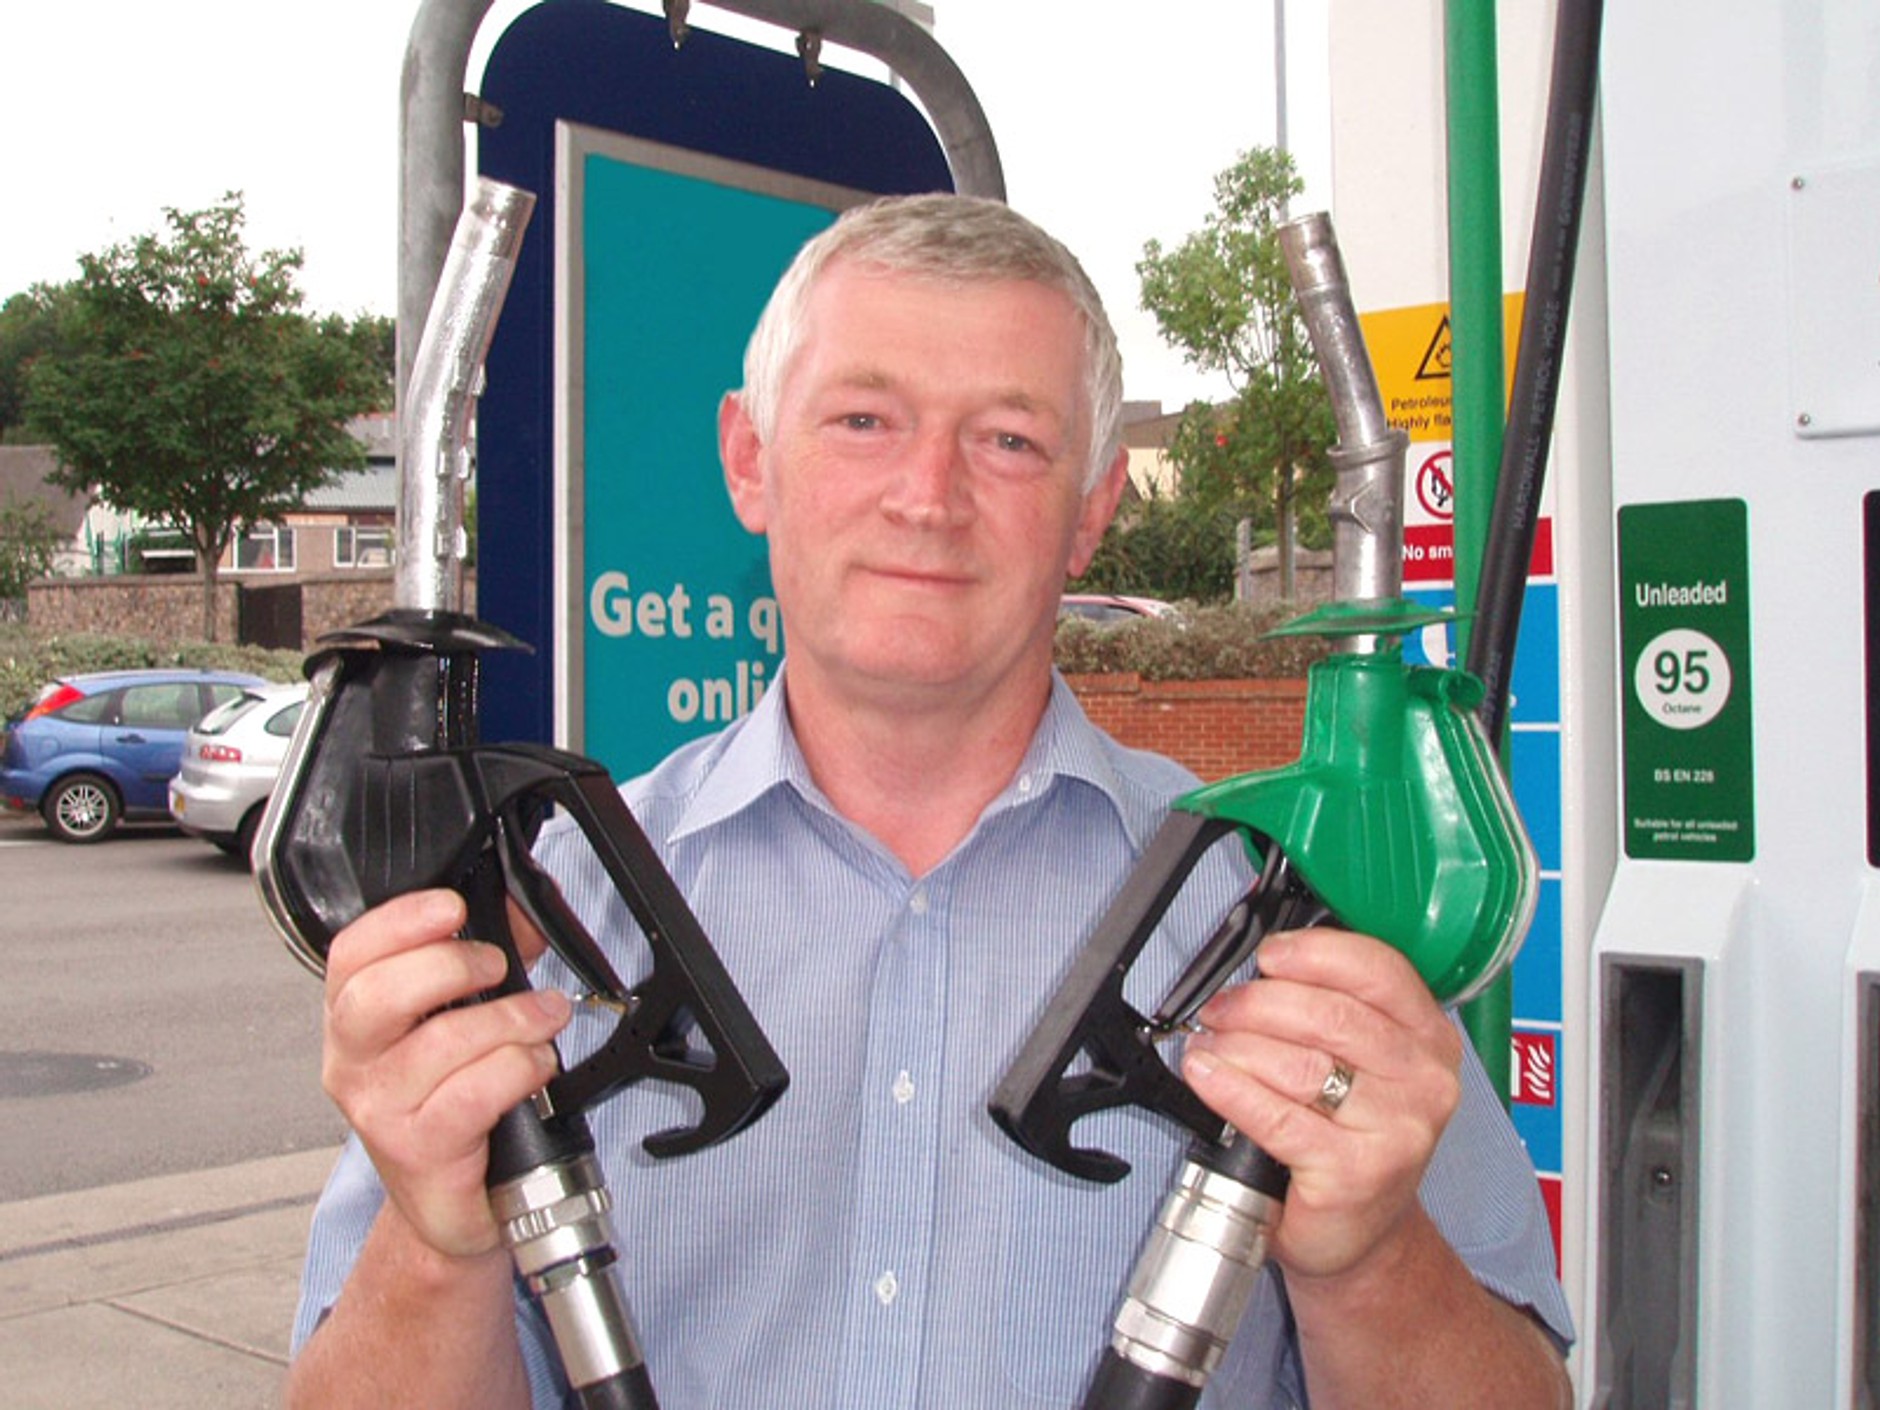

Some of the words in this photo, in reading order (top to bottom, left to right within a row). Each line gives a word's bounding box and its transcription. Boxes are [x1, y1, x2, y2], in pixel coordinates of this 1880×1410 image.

[1402, 545, 1424, 560] No
[1429, 544, 1453, 560] sm
[1635, 580, 1726, 607] Unleaded
[590, 570, 692, 638] Get
[705, 594, 734, 639] a
[748, 596, 778, 654] q
[1654, 650, 1710, 694] 95
[1662, 702, 1702, 714] Octane
[1654, 768, 1671, 782] BS
